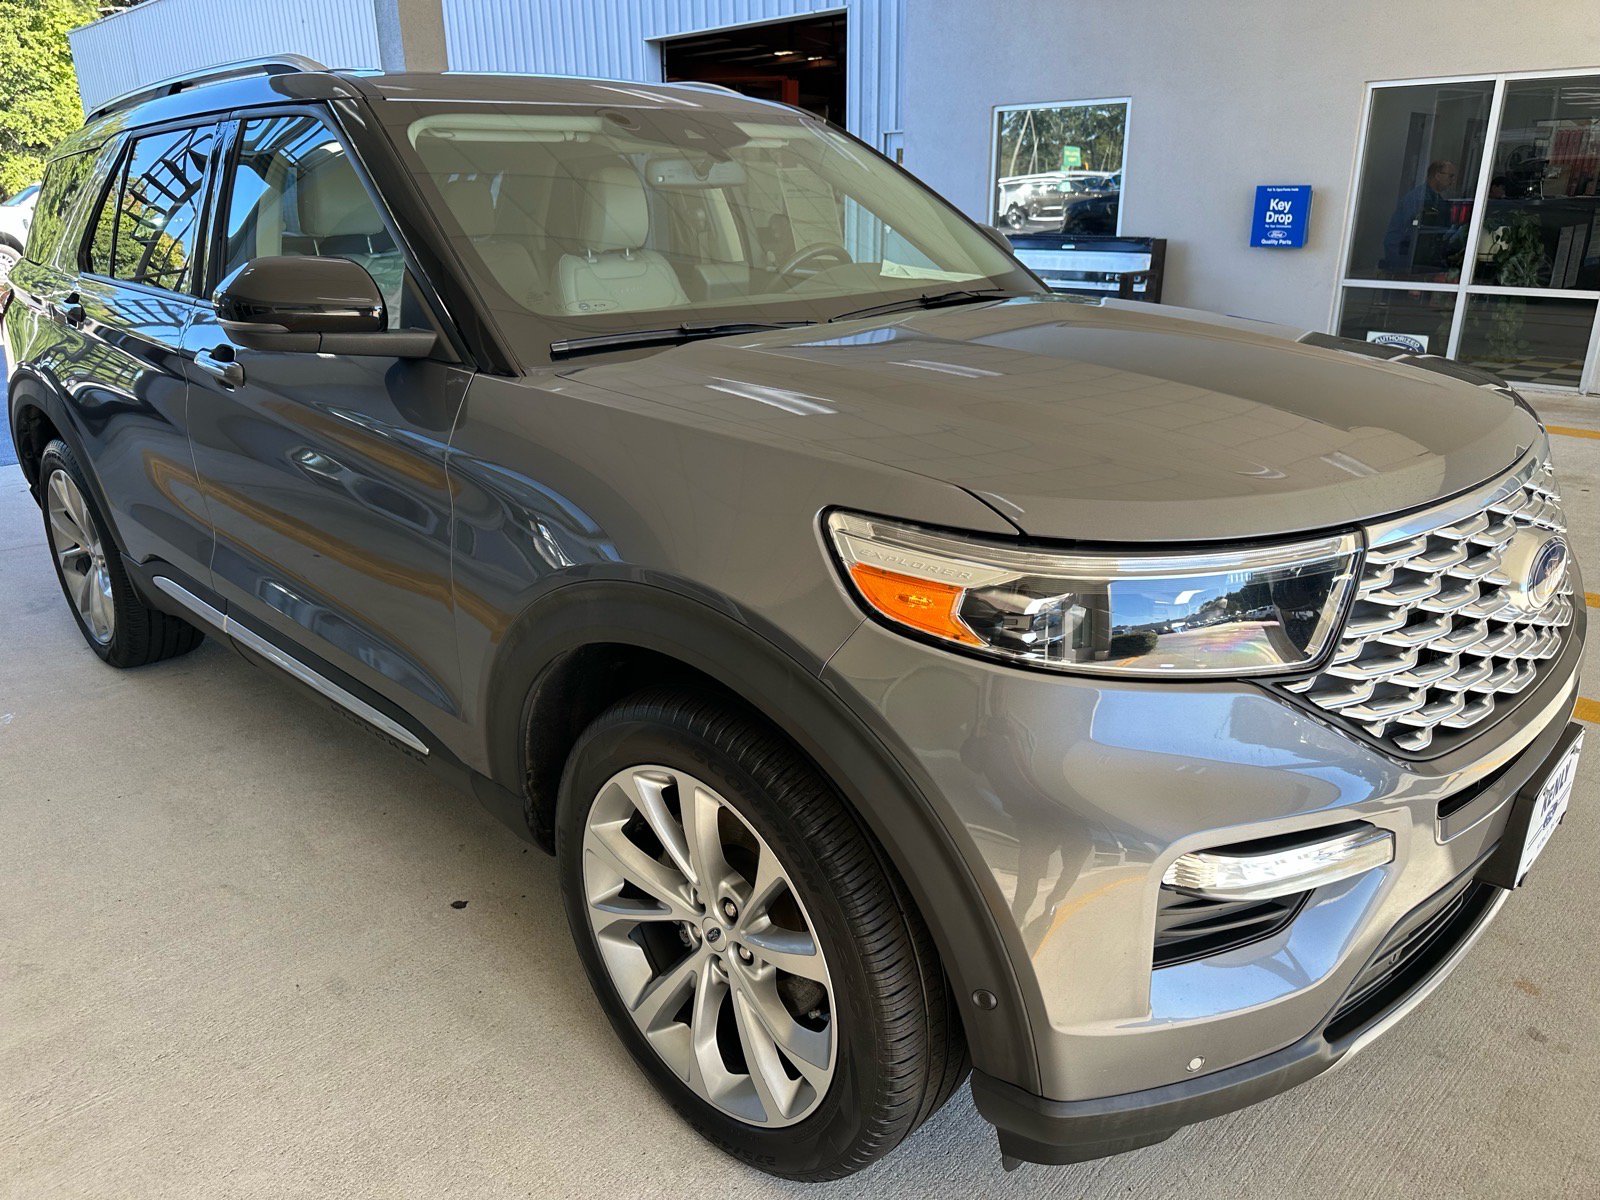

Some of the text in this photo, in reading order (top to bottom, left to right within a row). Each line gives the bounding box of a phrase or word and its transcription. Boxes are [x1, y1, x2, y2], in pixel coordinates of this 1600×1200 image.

[1269, 198, 1292, 213] Key
[1265, 211, 1292, 225] Drop
[1261, 238, 1279, 246] Quality
[1375, 334, 1420, 349] AUTHORIZED
[859, 548, 974, 581] EXPLORER
